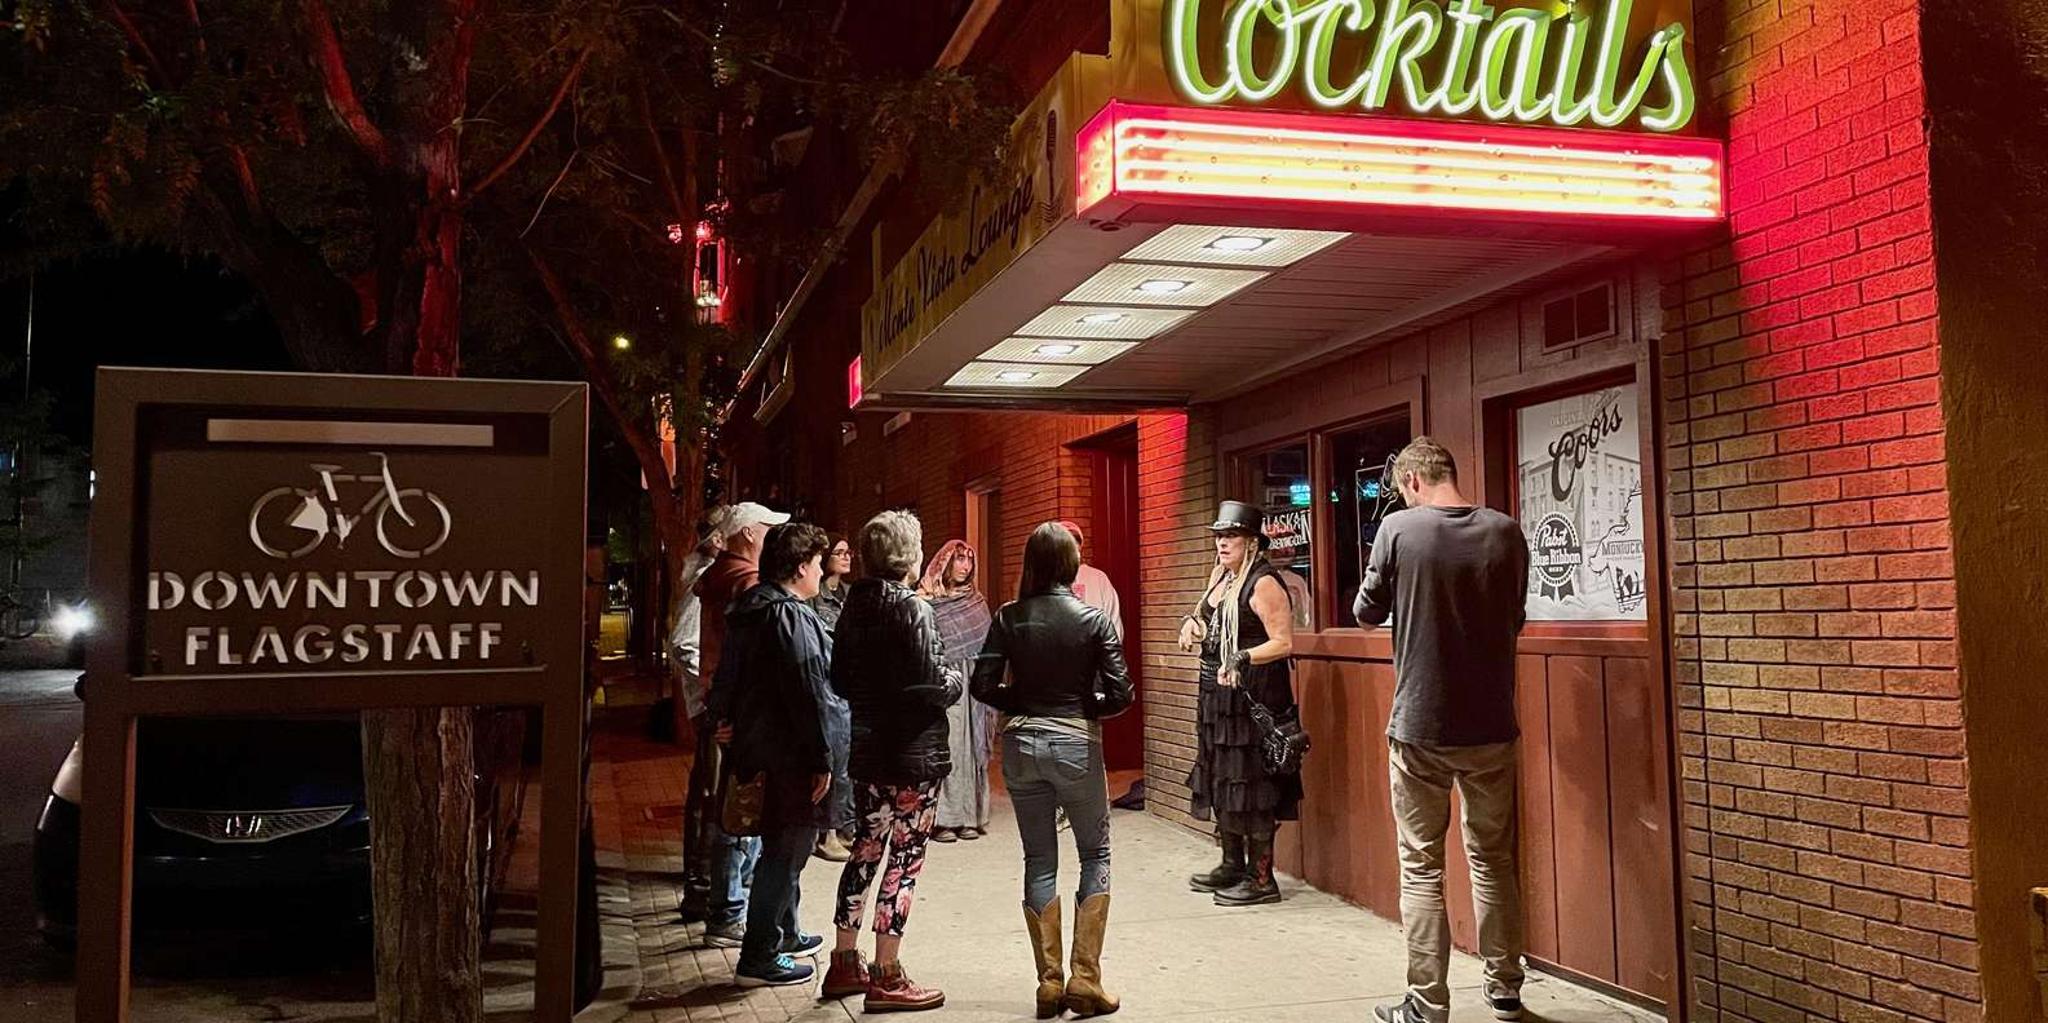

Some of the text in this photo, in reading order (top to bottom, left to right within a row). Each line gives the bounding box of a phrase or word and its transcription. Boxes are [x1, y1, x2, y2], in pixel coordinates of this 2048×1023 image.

[1166, 0, 1696, 132] Cocktails
[879, 175, 1033, 352] Monte Vista Lounge
[1548, 403, 1623, 501] Coors
[1540, 524, 1568, 547] Pabst
[1531, 548, 1581, 567] Blue Ribbon
[147, 570, 539, 610] DOWNTOWN
[185, 622, 502, 665] FLAGSTAFF
